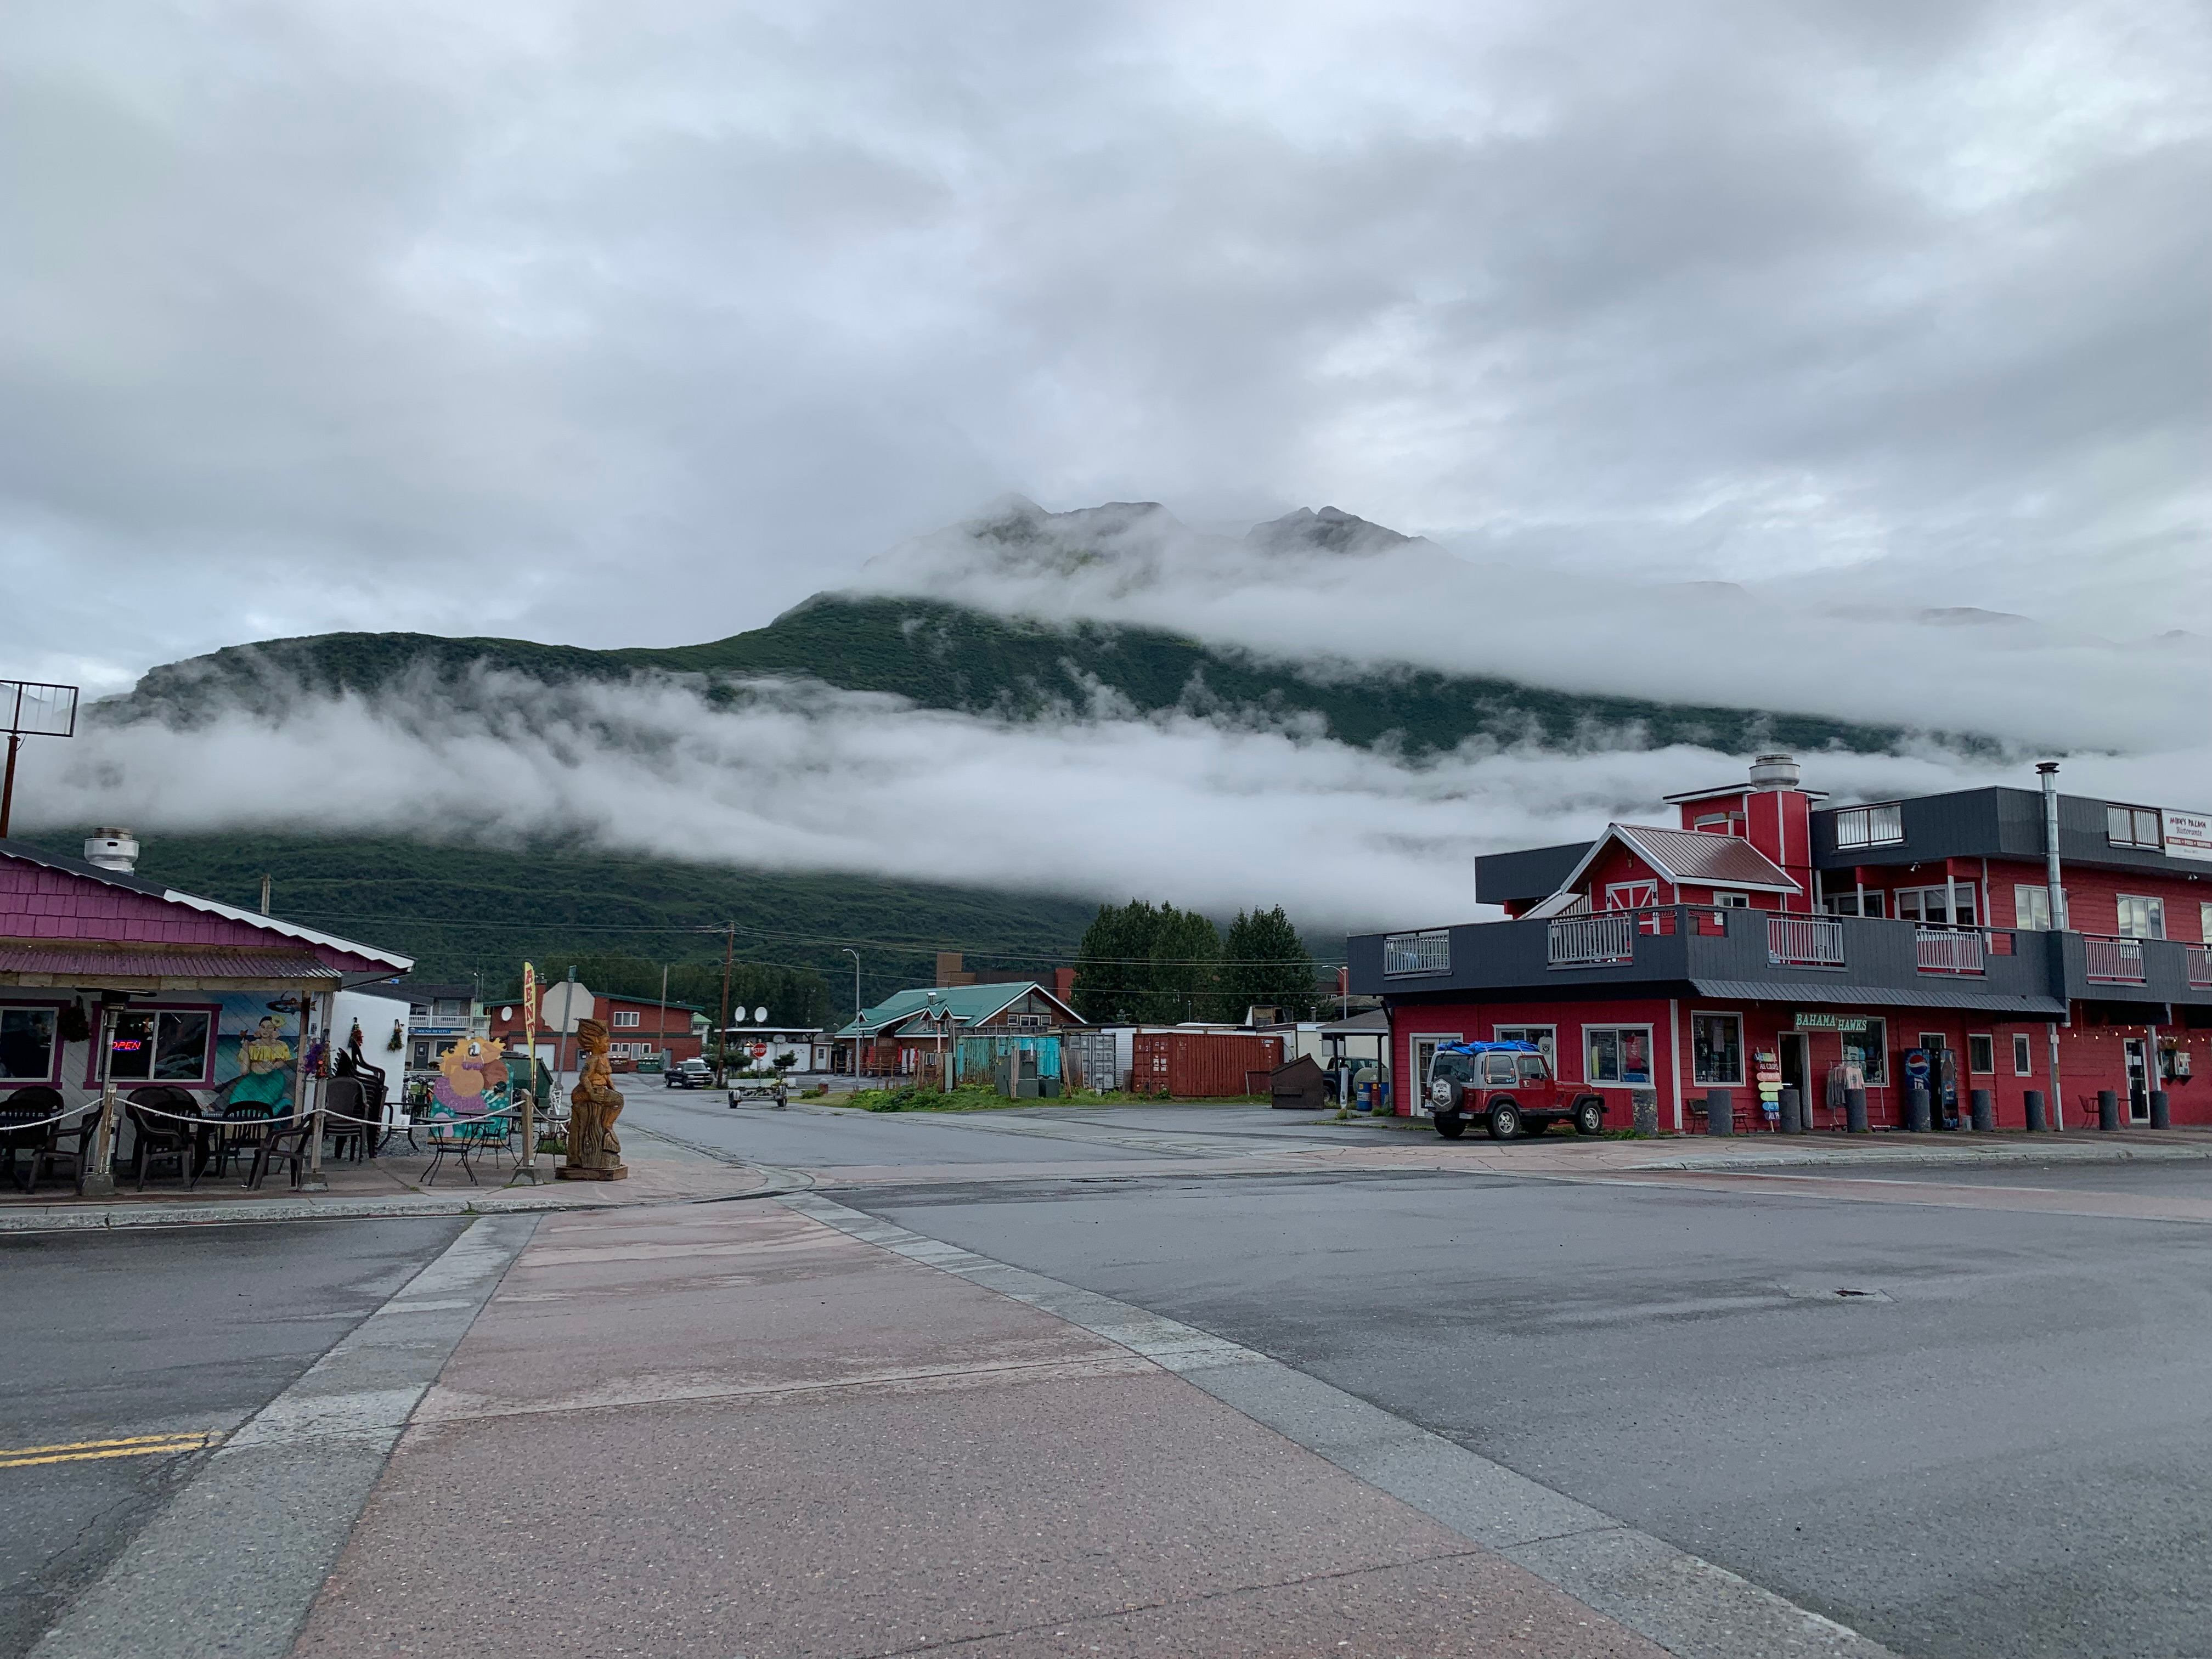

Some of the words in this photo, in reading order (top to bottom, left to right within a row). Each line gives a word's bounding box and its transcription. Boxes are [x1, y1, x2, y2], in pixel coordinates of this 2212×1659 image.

[1796, 1014, 1836, 1026] BAHAMA
[1837, 1019, 1867, 1031] HAWKS
[112, 1041, 142, 1049] OPEN
